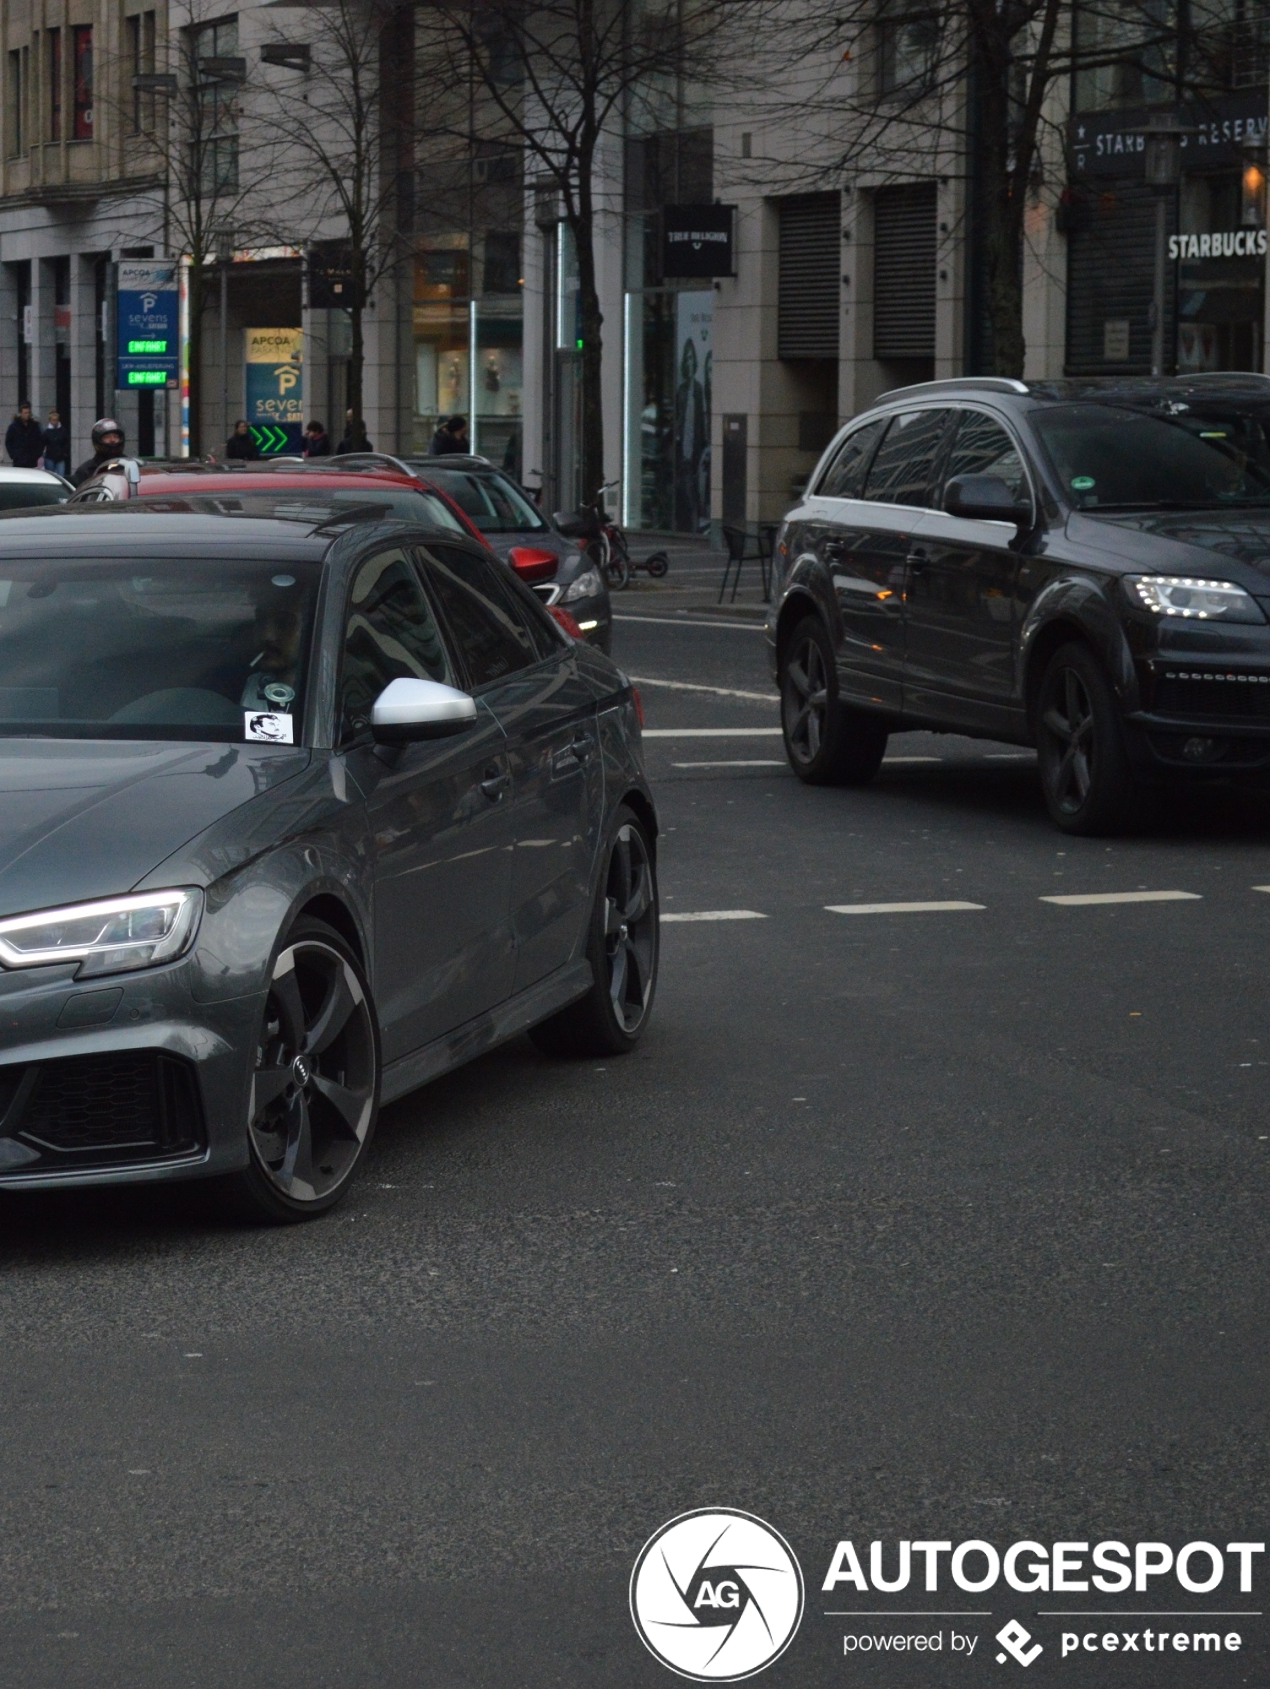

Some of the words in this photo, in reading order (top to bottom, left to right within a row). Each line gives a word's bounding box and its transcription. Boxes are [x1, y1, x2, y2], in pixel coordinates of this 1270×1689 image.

[1168, 229, 1268, 260] STARBUCKS
[128, 313, 168, 323] sevens
[251, 336, 291, 346] APCOA
